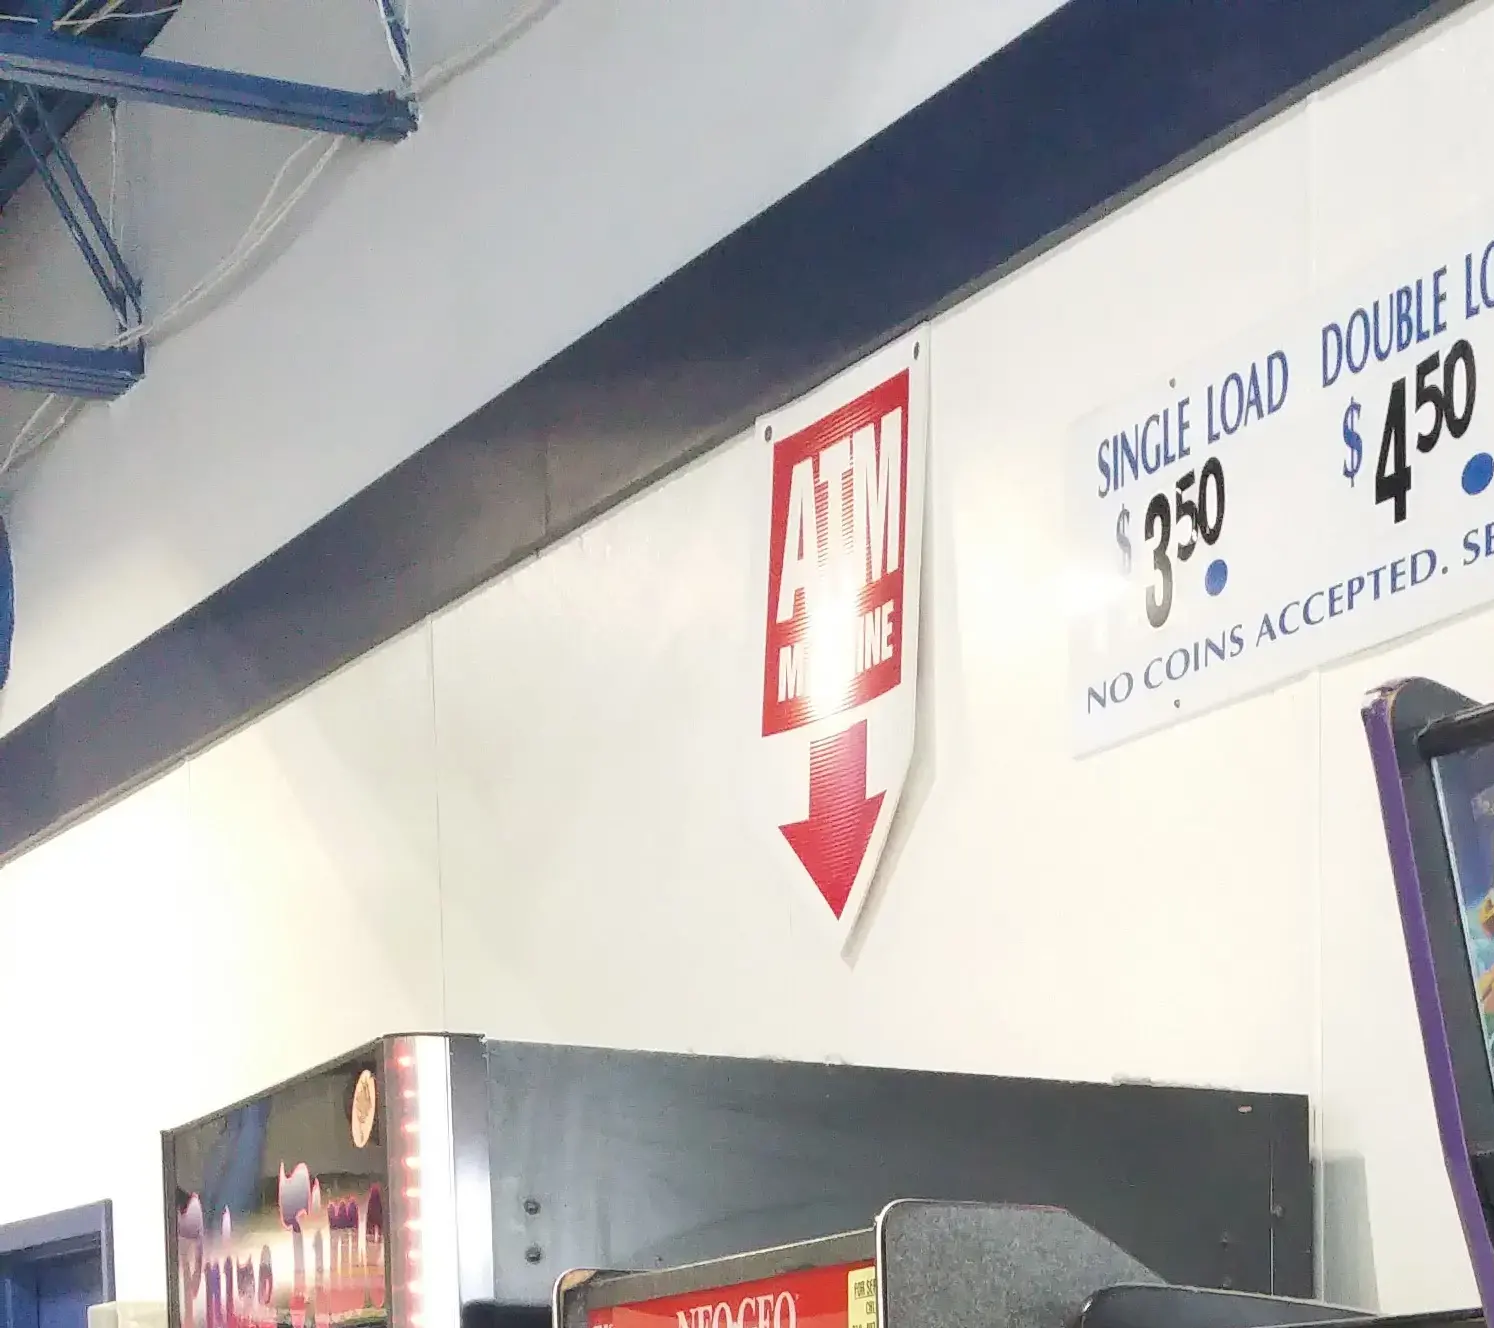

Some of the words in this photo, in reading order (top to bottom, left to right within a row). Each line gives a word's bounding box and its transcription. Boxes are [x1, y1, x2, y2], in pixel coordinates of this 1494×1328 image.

[1322, 265, 1448, 389] DOUBLE
[1097, 398, 1191, 499] SINGLE
[1206, 349, 1290, 445] LOAD
[775, 406, 903, 625] ATM
[1087, 671, 1134, 715] NO
[1143, 624, 1245, 690] COINS
[1255, 547, 1450, 647] ACCEPTED.
